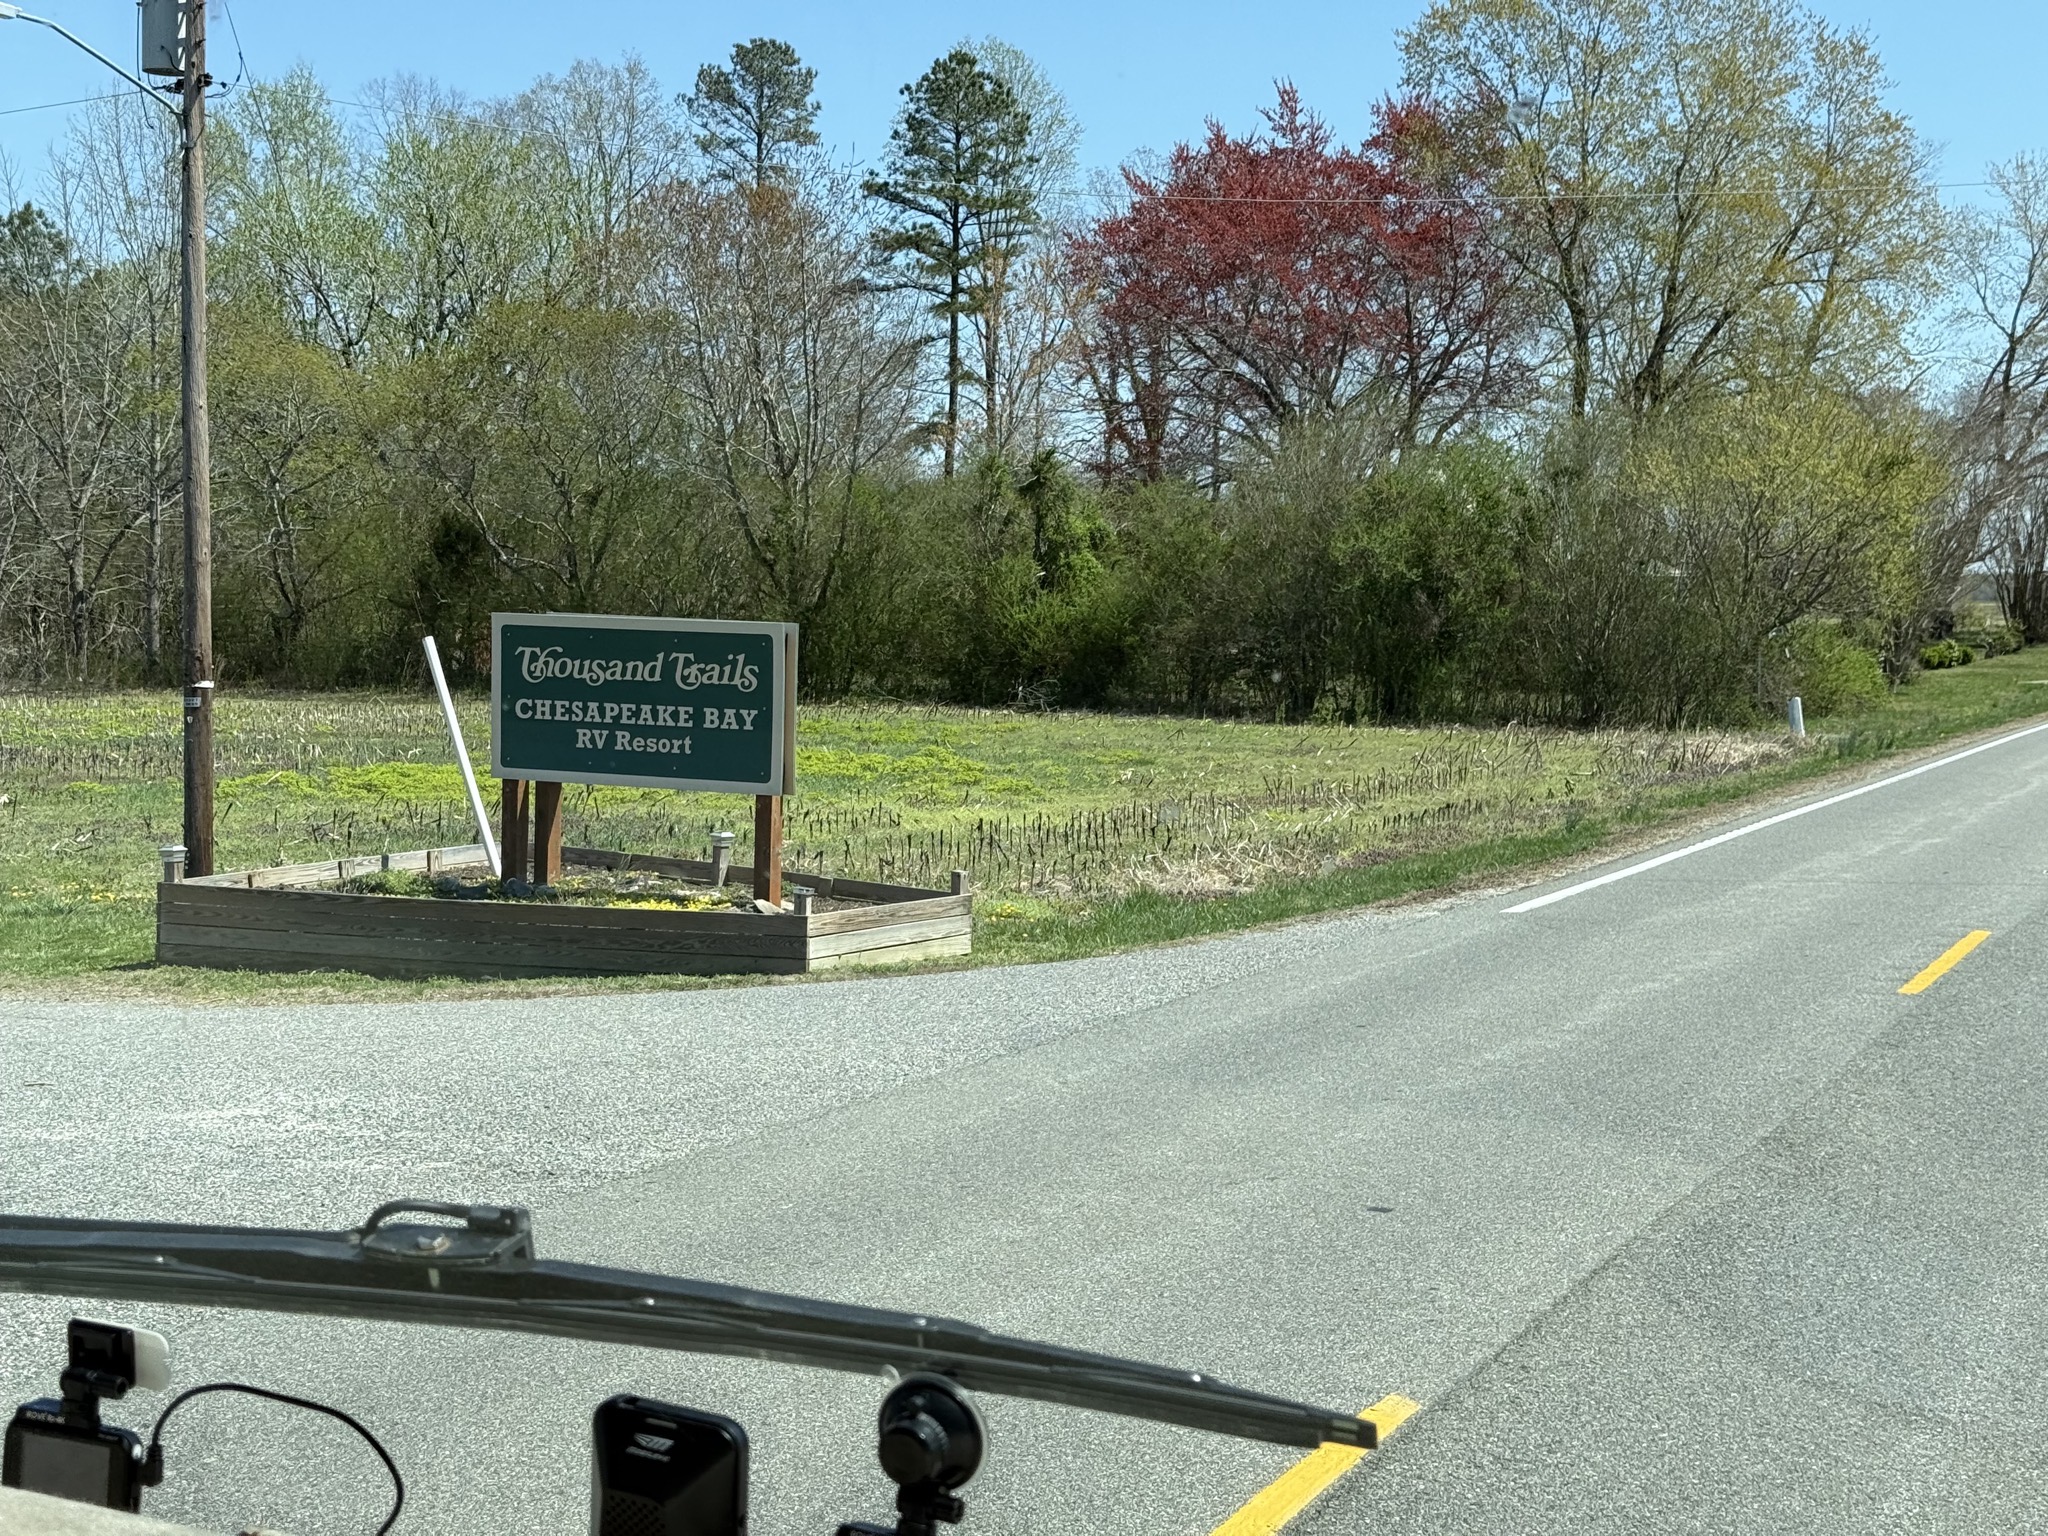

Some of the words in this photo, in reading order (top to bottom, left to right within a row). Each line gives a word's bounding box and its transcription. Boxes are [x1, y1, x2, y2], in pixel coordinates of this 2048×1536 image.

[515, 646, 664, 686] Thousand
[668, 652, 759, 692] Trails
[514, 698, 694, 727] CHESAPEAKE
[702, 707, 759, 730] BAY
[575, 728, 609, 749] RV
[615, 730, 692, 754] Resort
